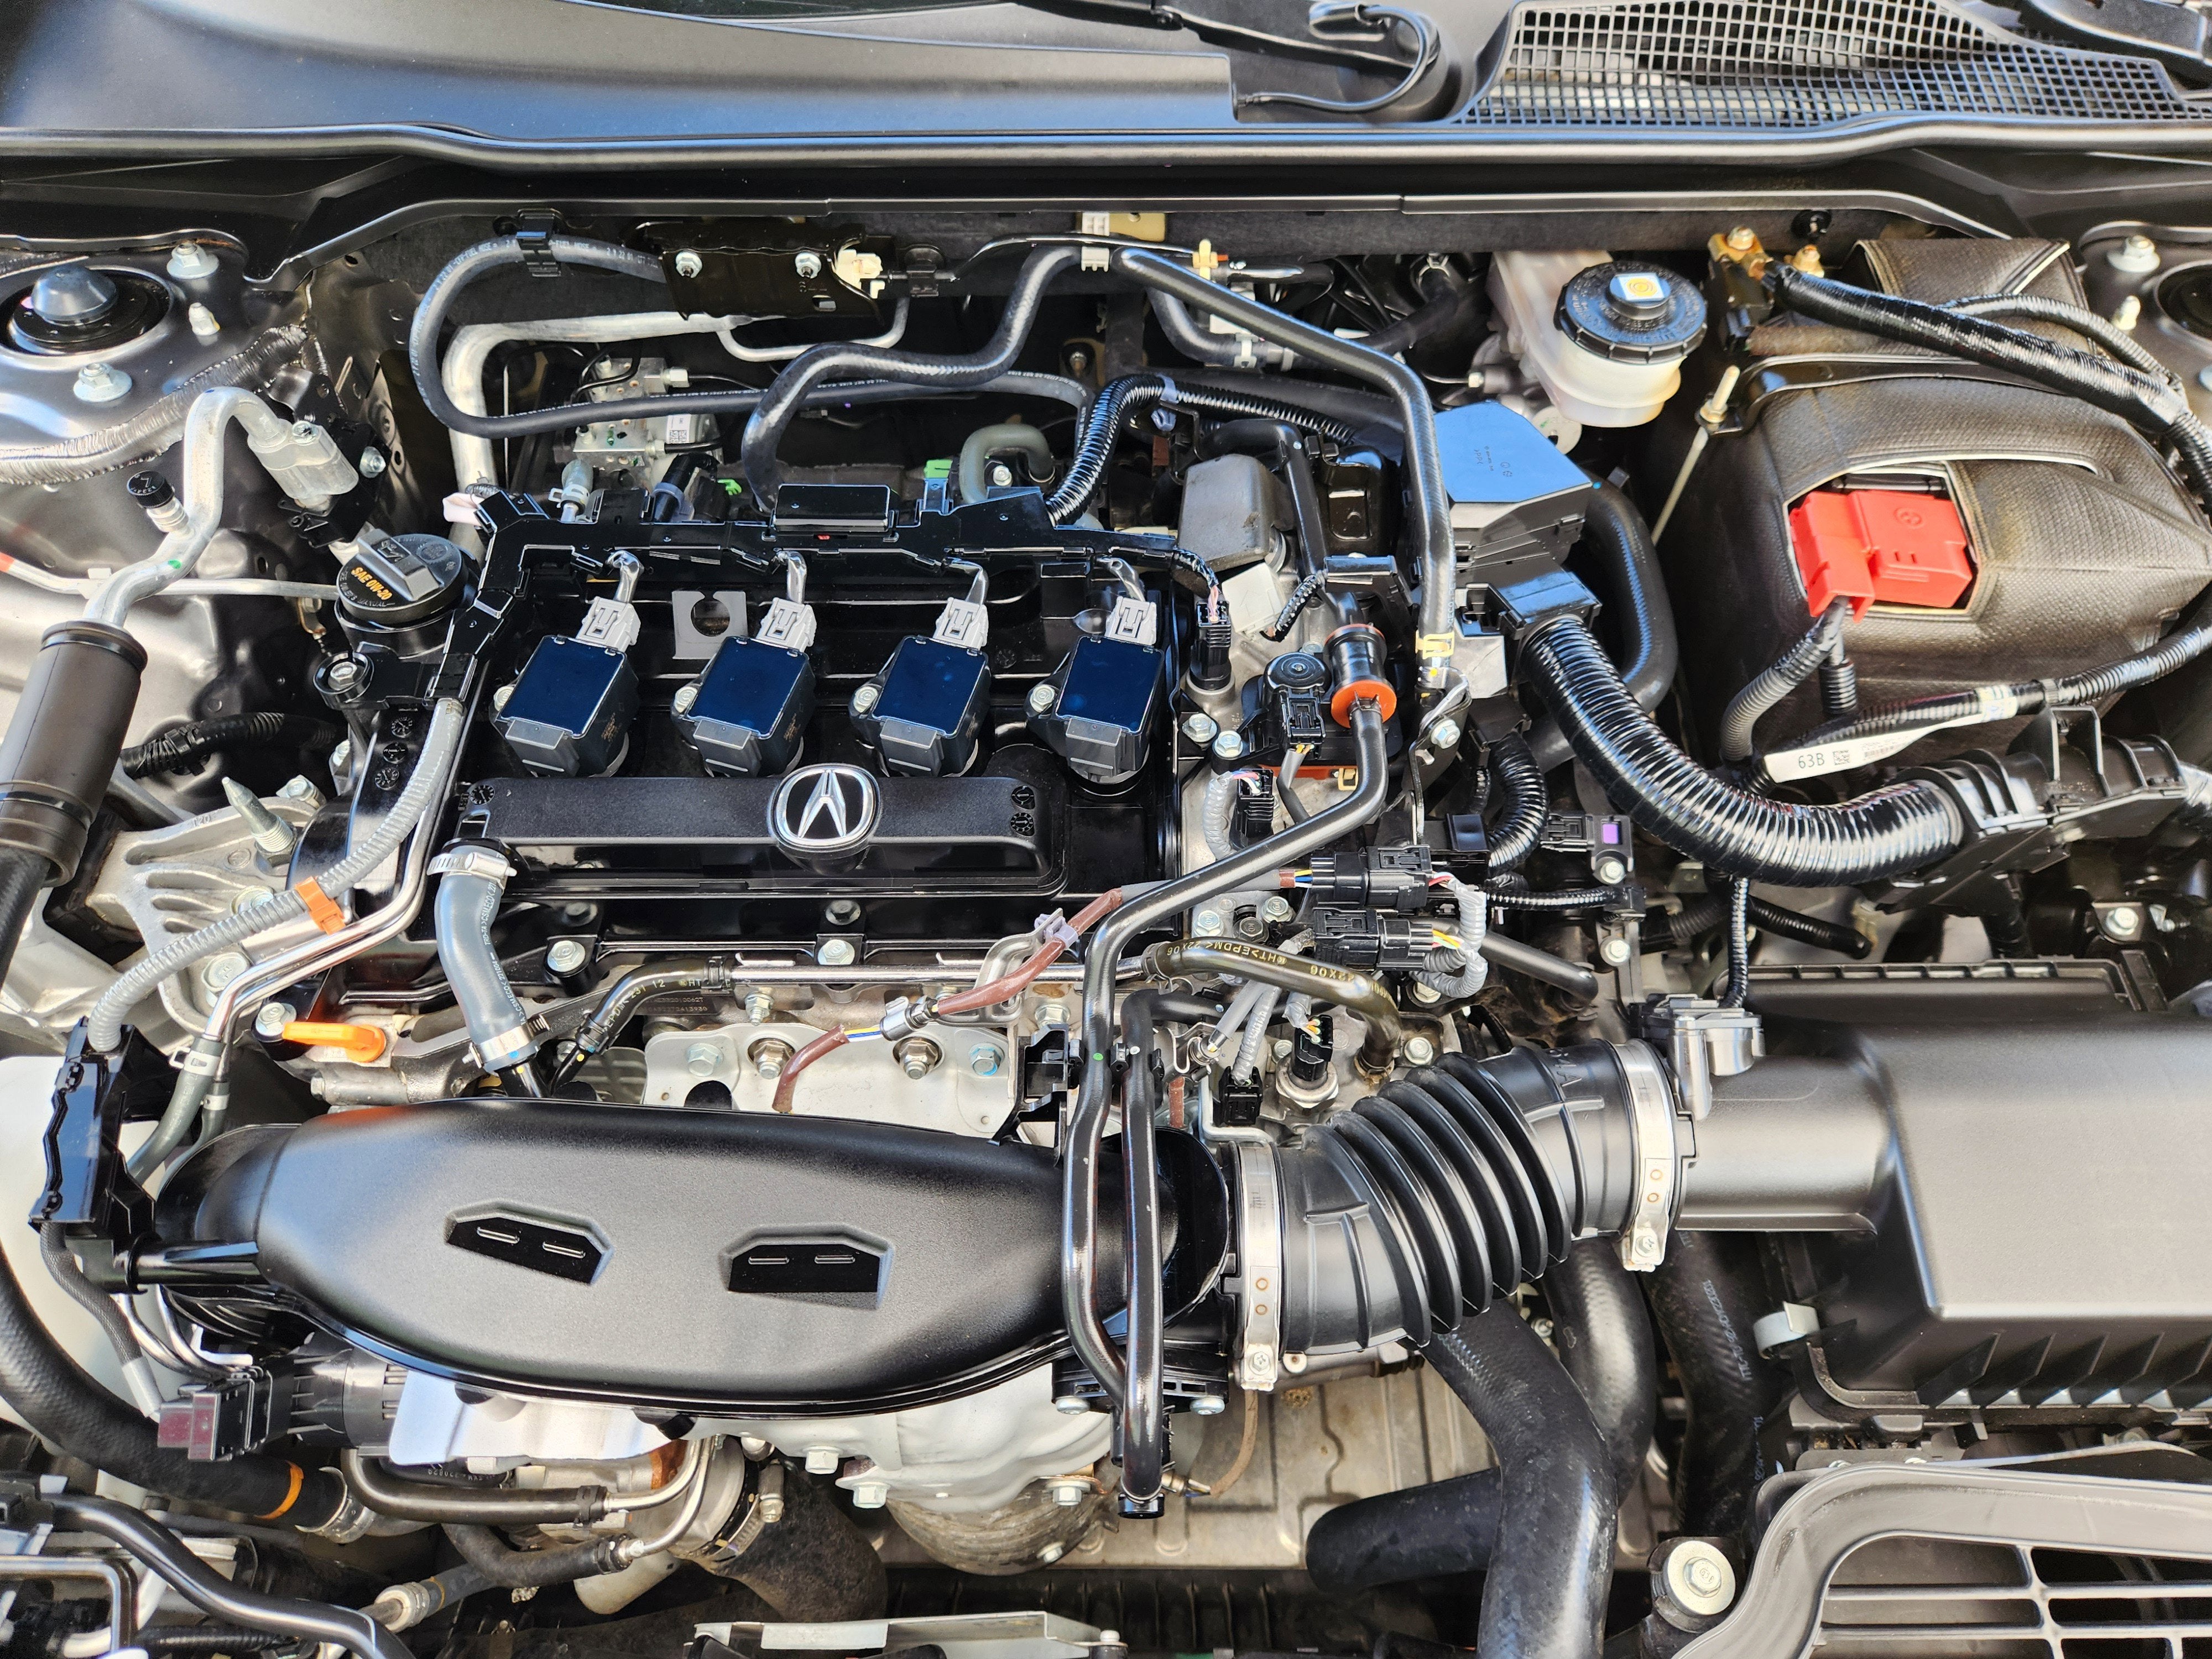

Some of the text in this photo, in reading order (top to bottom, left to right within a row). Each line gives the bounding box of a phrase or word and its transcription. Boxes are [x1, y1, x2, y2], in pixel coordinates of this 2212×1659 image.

[351, 566, 393, 601] SAE 0W-20
[1798, 753, 1825, 769] 63B
